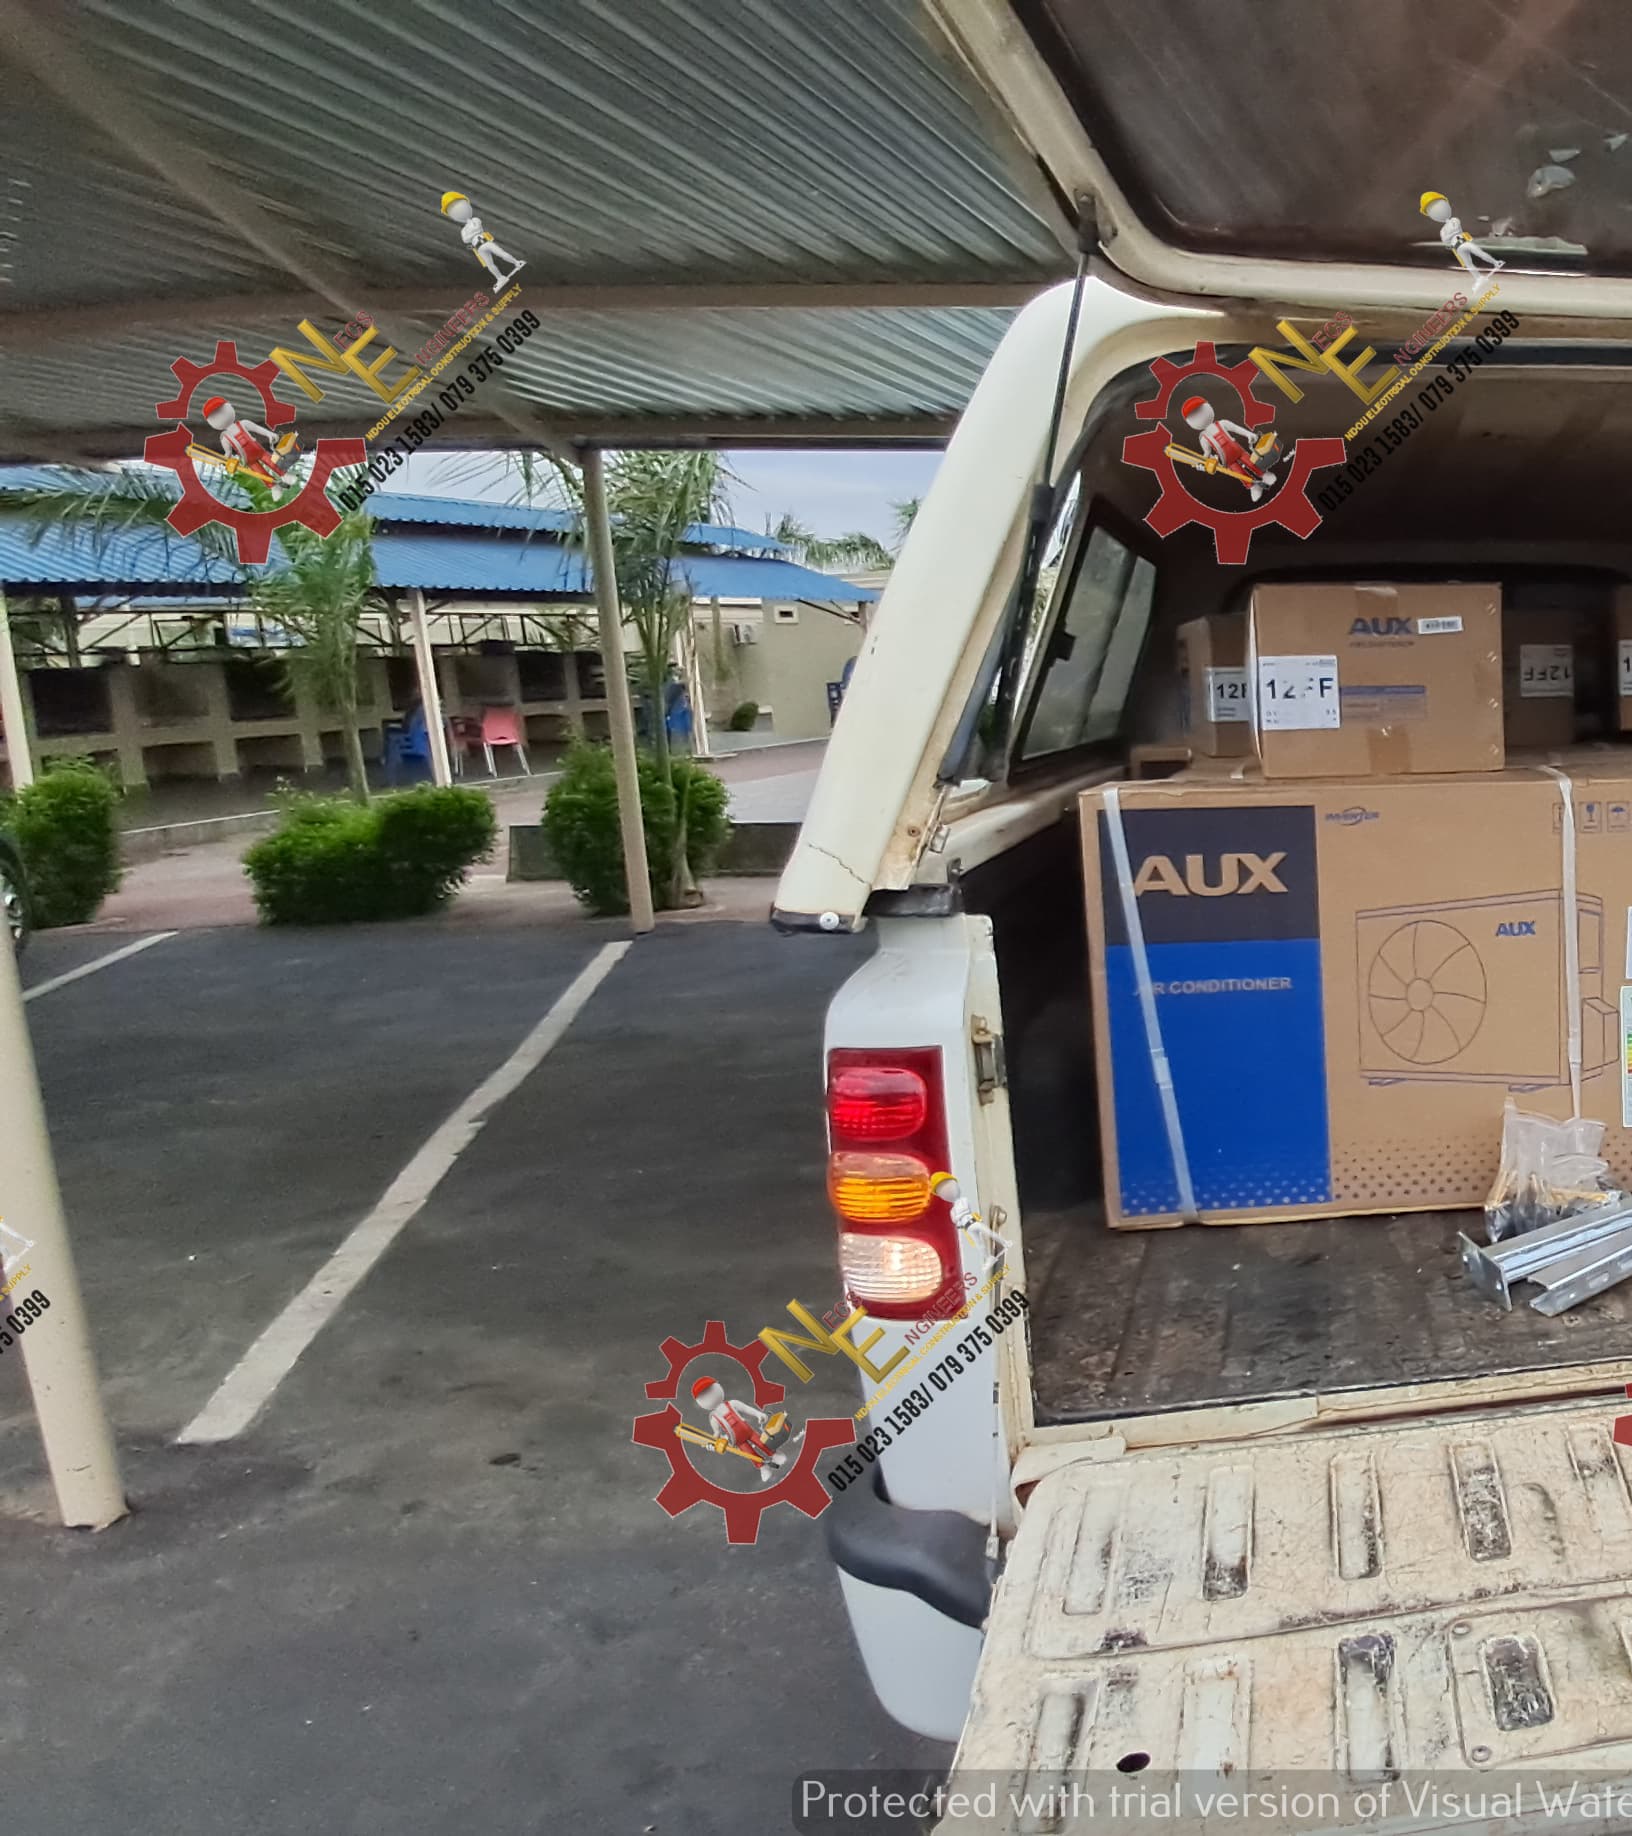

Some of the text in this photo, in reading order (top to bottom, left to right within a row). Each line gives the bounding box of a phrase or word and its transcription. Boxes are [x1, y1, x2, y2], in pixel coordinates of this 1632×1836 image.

[1348, 617, 1413, 637] AUX
[1523, 665, 1570, 681] 12FF
[1133, 852, 1289, 897] AUX
[1495, 920, 1536, 936] AUX
[1169, 977, 1292, 995] CONDITIONER
